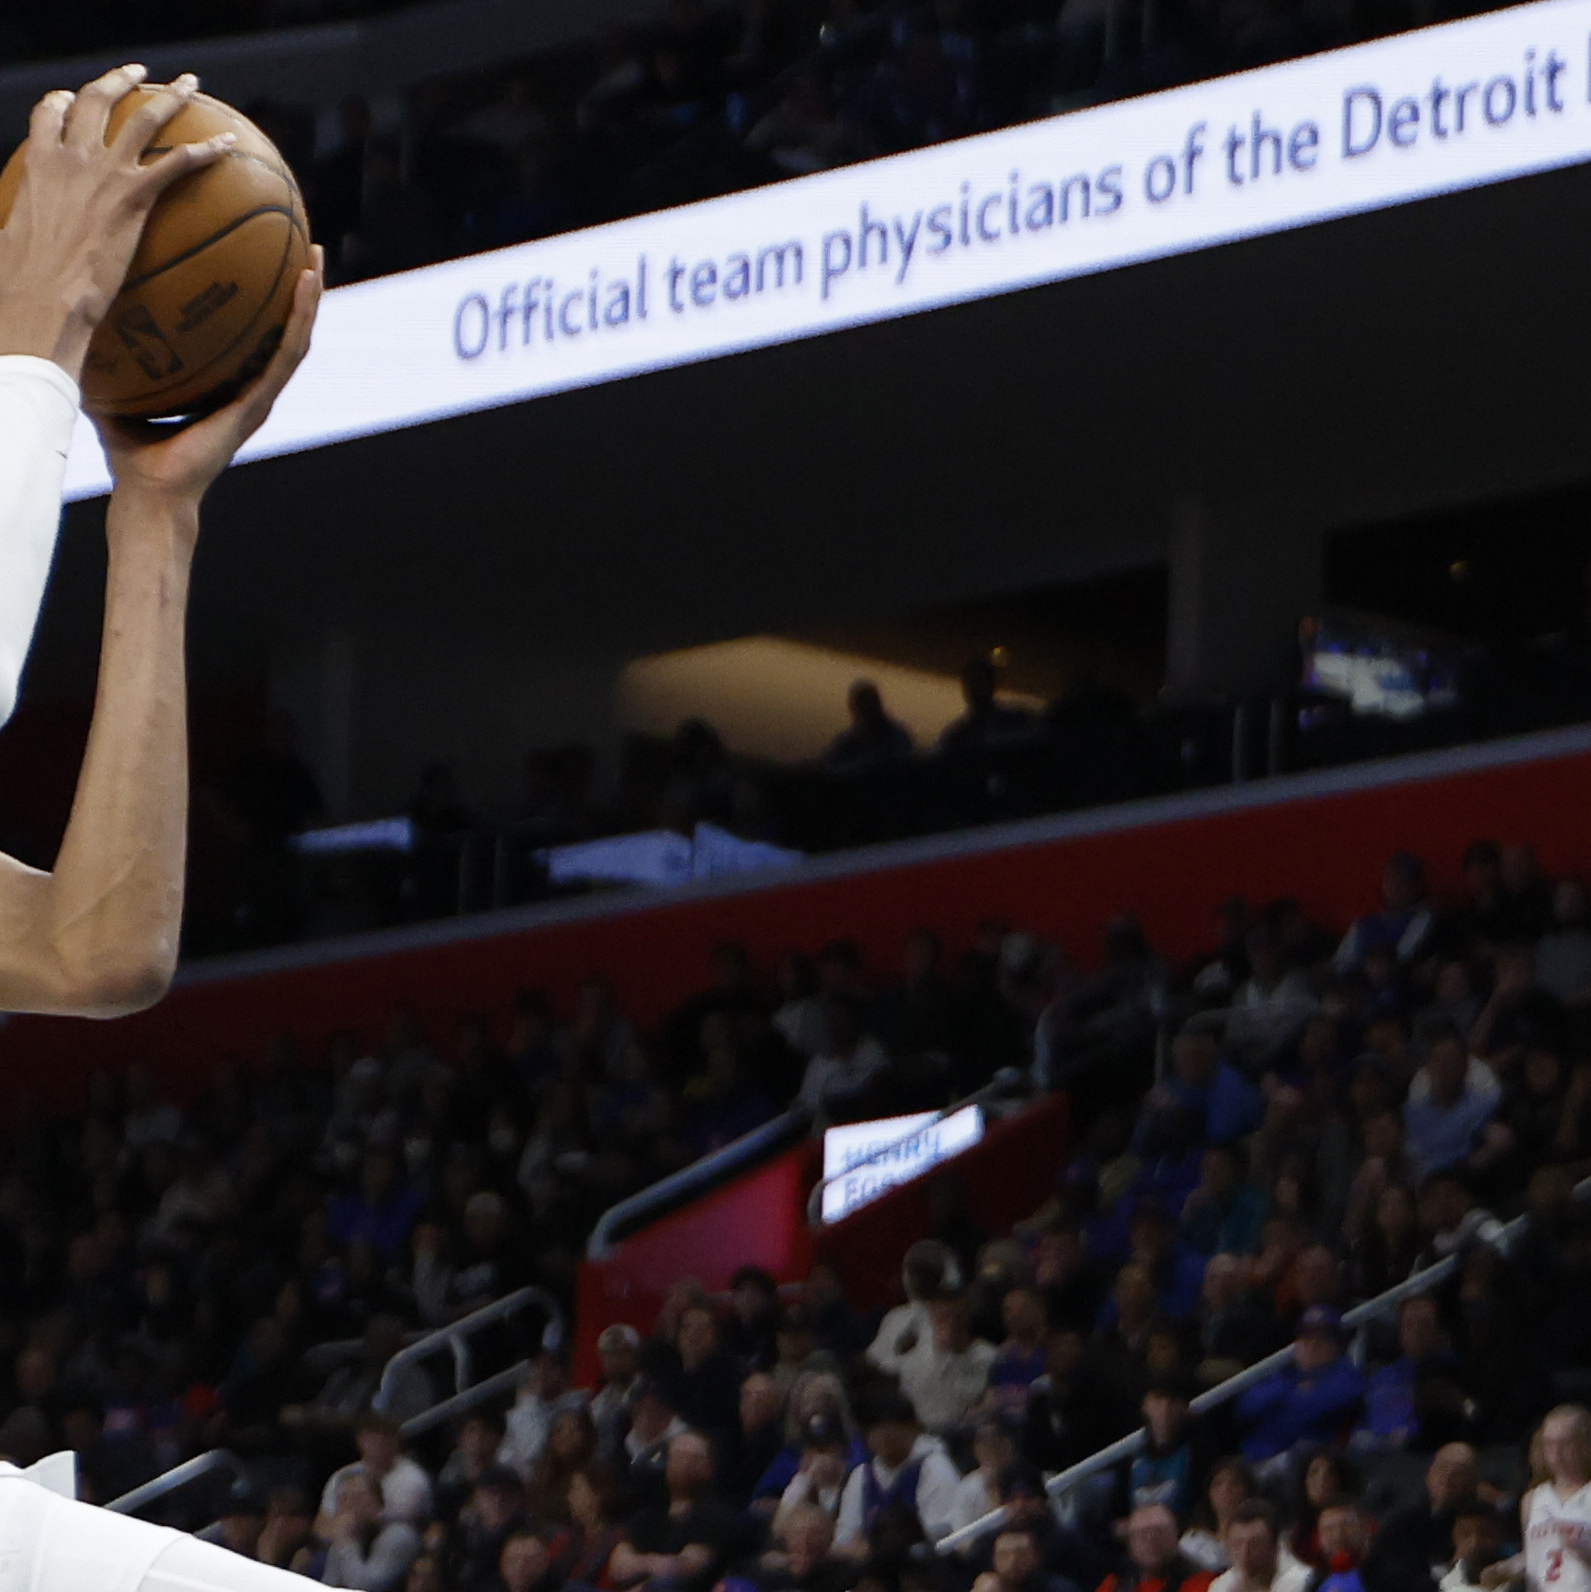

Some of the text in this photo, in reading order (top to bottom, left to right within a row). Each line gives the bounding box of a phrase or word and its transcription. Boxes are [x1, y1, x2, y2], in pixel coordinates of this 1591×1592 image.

[453, 253, 649, 363] Official
[668, 234, 805, 315] team
[821, 162, 1124, 300] physicians
[1144, 120, 1207, 205] of
[1225, 107, 1320, 184] the
[1341, 51, 1568, 162] Detroit
